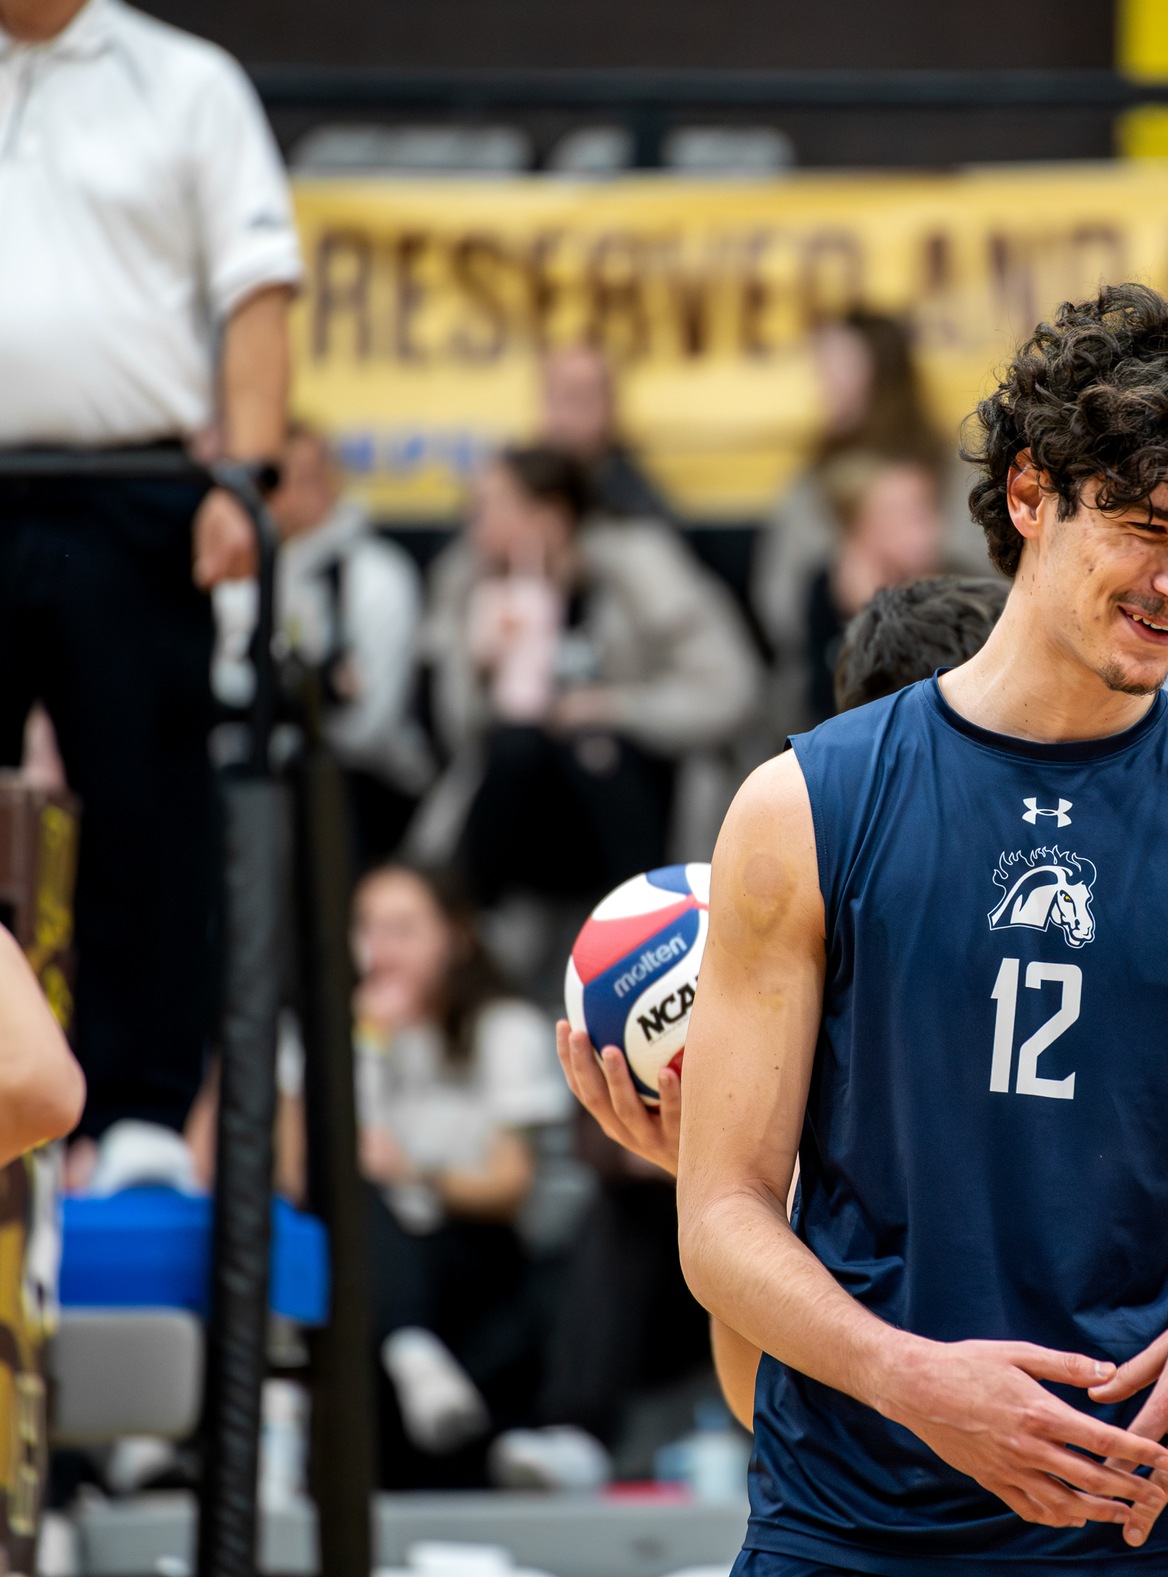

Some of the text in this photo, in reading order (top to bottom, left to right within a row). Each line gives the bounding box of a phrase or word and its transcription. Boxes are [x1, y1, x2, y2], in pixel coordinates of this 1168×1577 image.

[311, 228, 862, 362] RESERVED
[613, 936, 687, 998] molten
[637, 974, 698, 1042] NCA
[990, 957, 1083, 1100] 12
